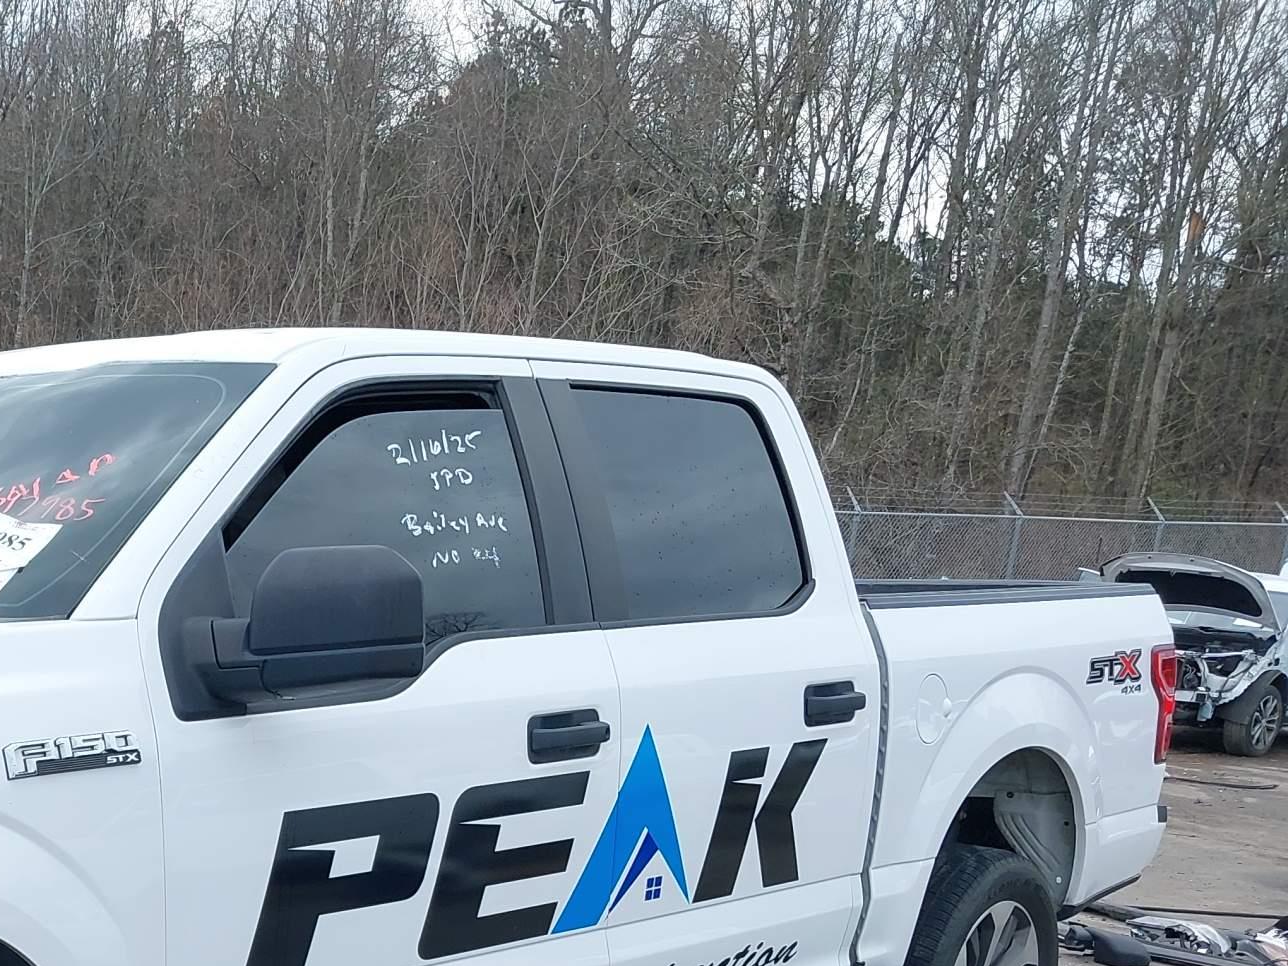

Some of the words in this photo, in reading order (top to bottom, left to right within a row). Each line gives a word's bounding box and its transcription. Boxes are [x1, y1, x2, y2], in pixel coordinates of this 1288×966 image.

[387, 430, 481, 466] 2/16/25
[1086, 648, 1142, 685] STX
[106, 753, 140, 764] STX
